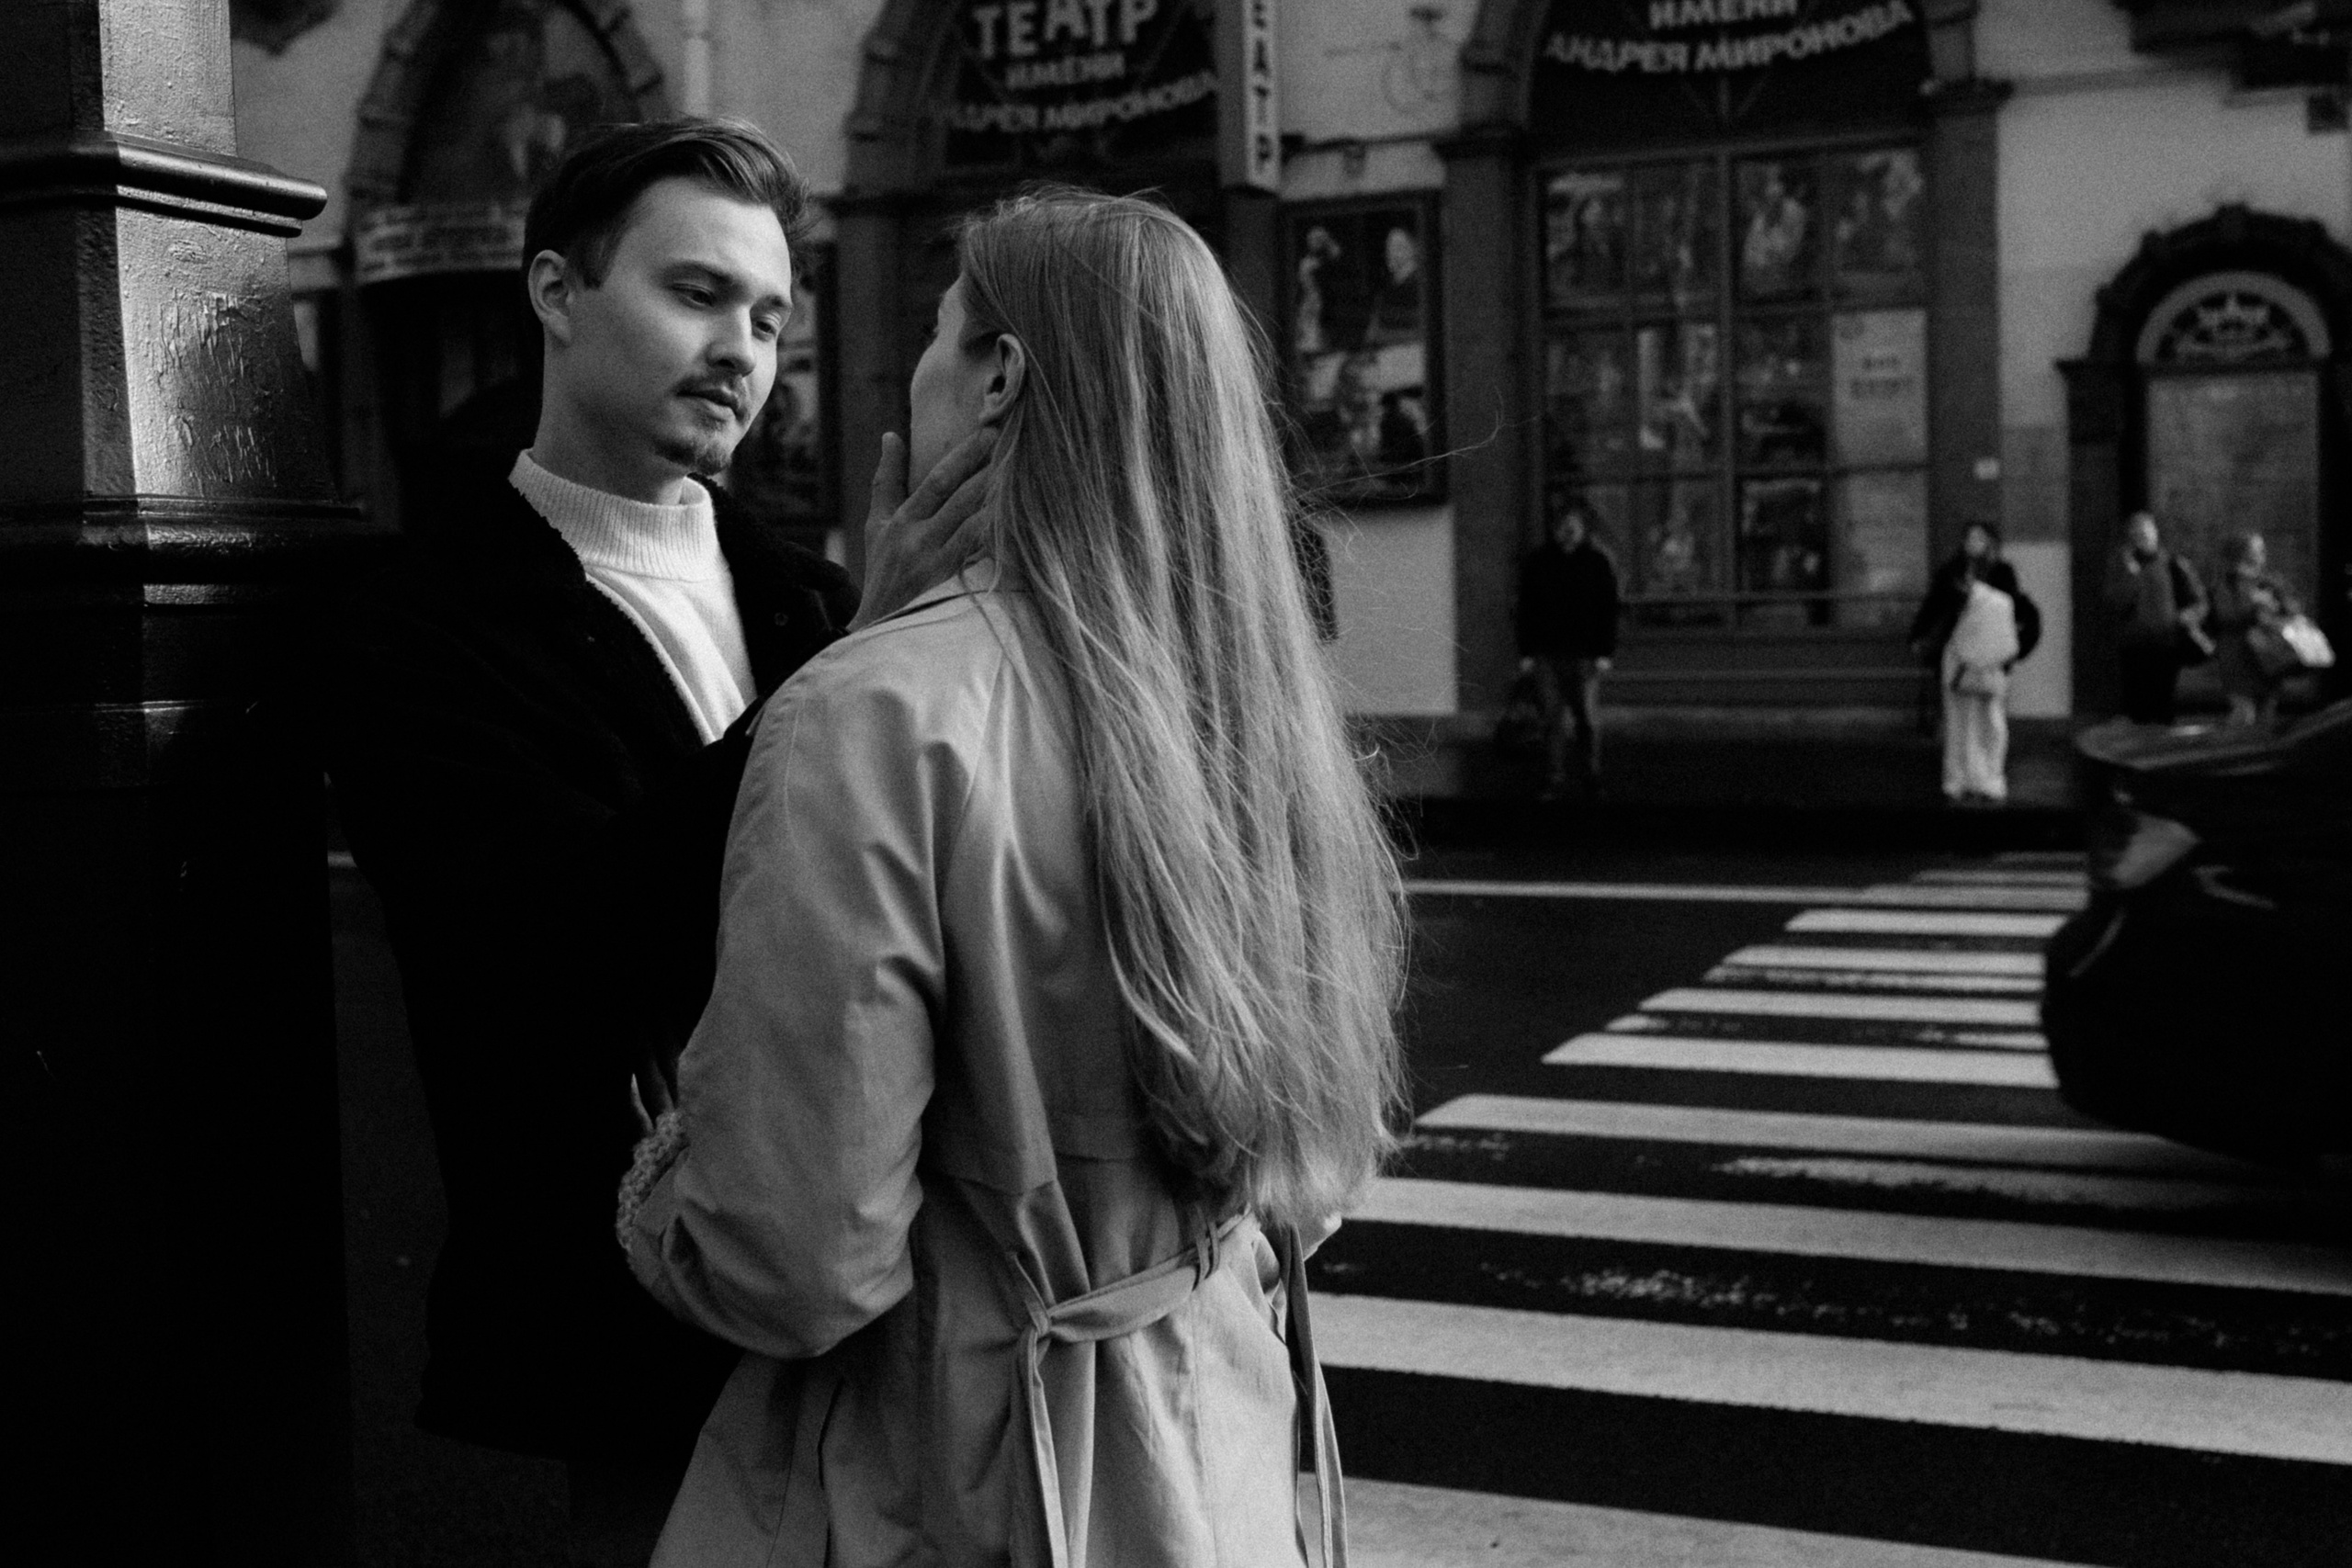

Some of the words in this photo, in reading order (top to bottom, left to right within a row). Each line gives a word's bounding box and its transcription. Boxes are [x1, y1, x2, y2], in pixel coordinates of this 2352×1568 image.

[971, 0, 1158, 59] ТЕАТР
[1544, 32, 1689, 73] АНДРЕЯ
[1693, 0, 1914, 72] МИРОНОВА
